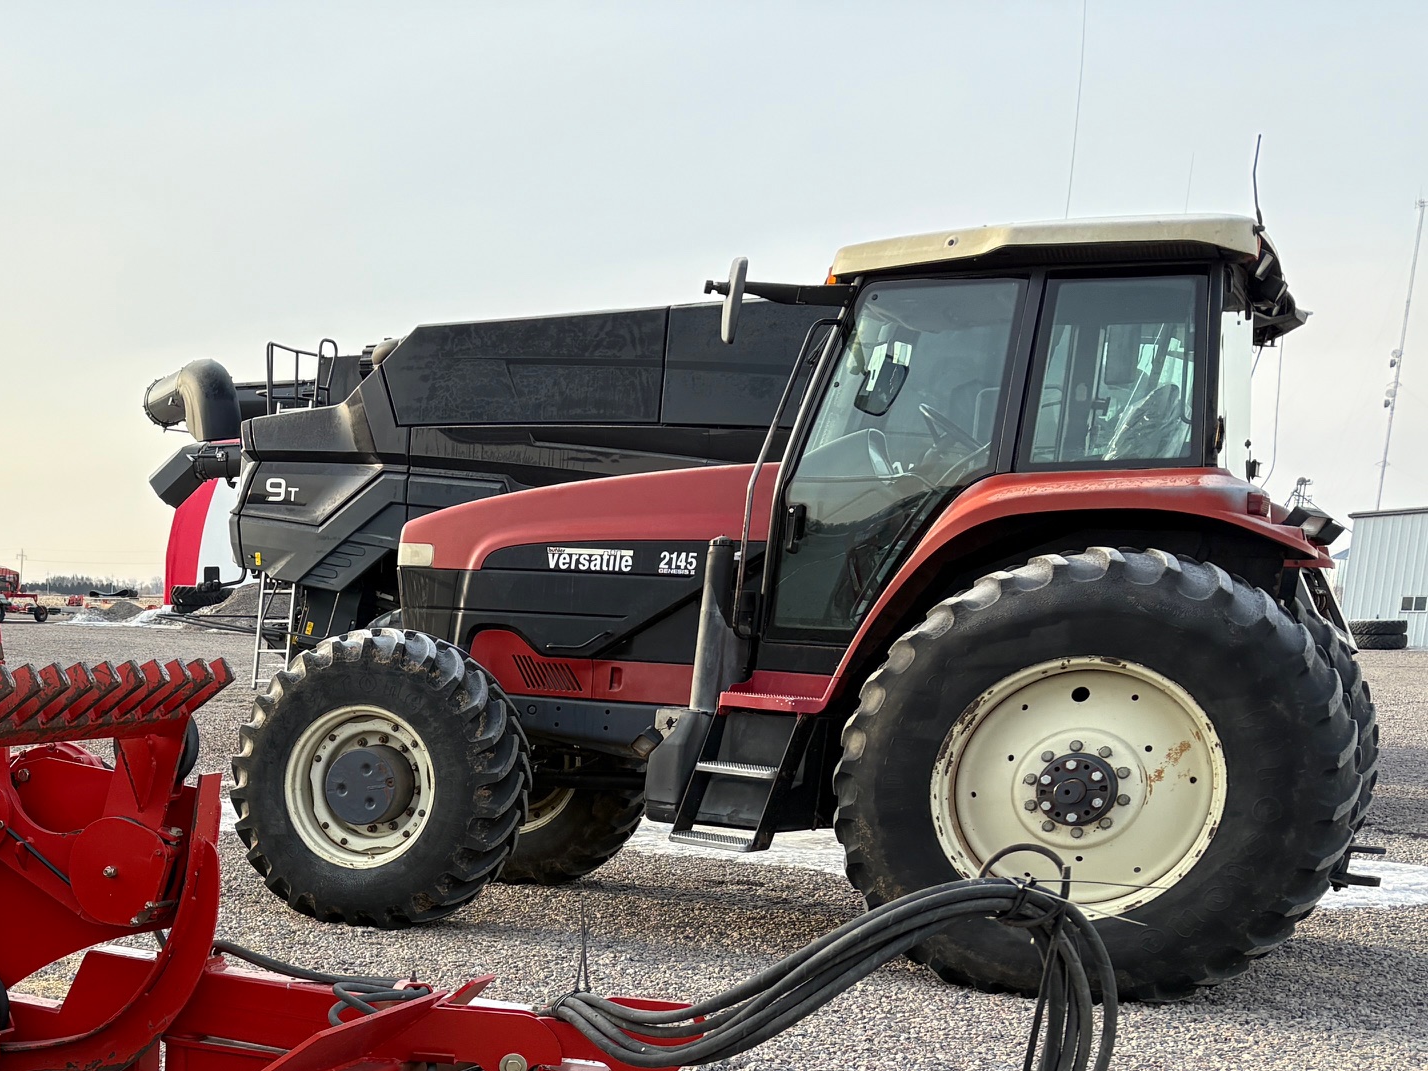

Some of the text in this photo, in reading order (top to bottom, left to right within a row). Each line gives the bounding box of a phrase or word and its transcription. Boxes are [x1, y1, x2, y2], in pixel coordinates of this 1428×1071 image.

[265, 477, 300, 501] 9T
[548, 550, 697, 572] versatile 2145
